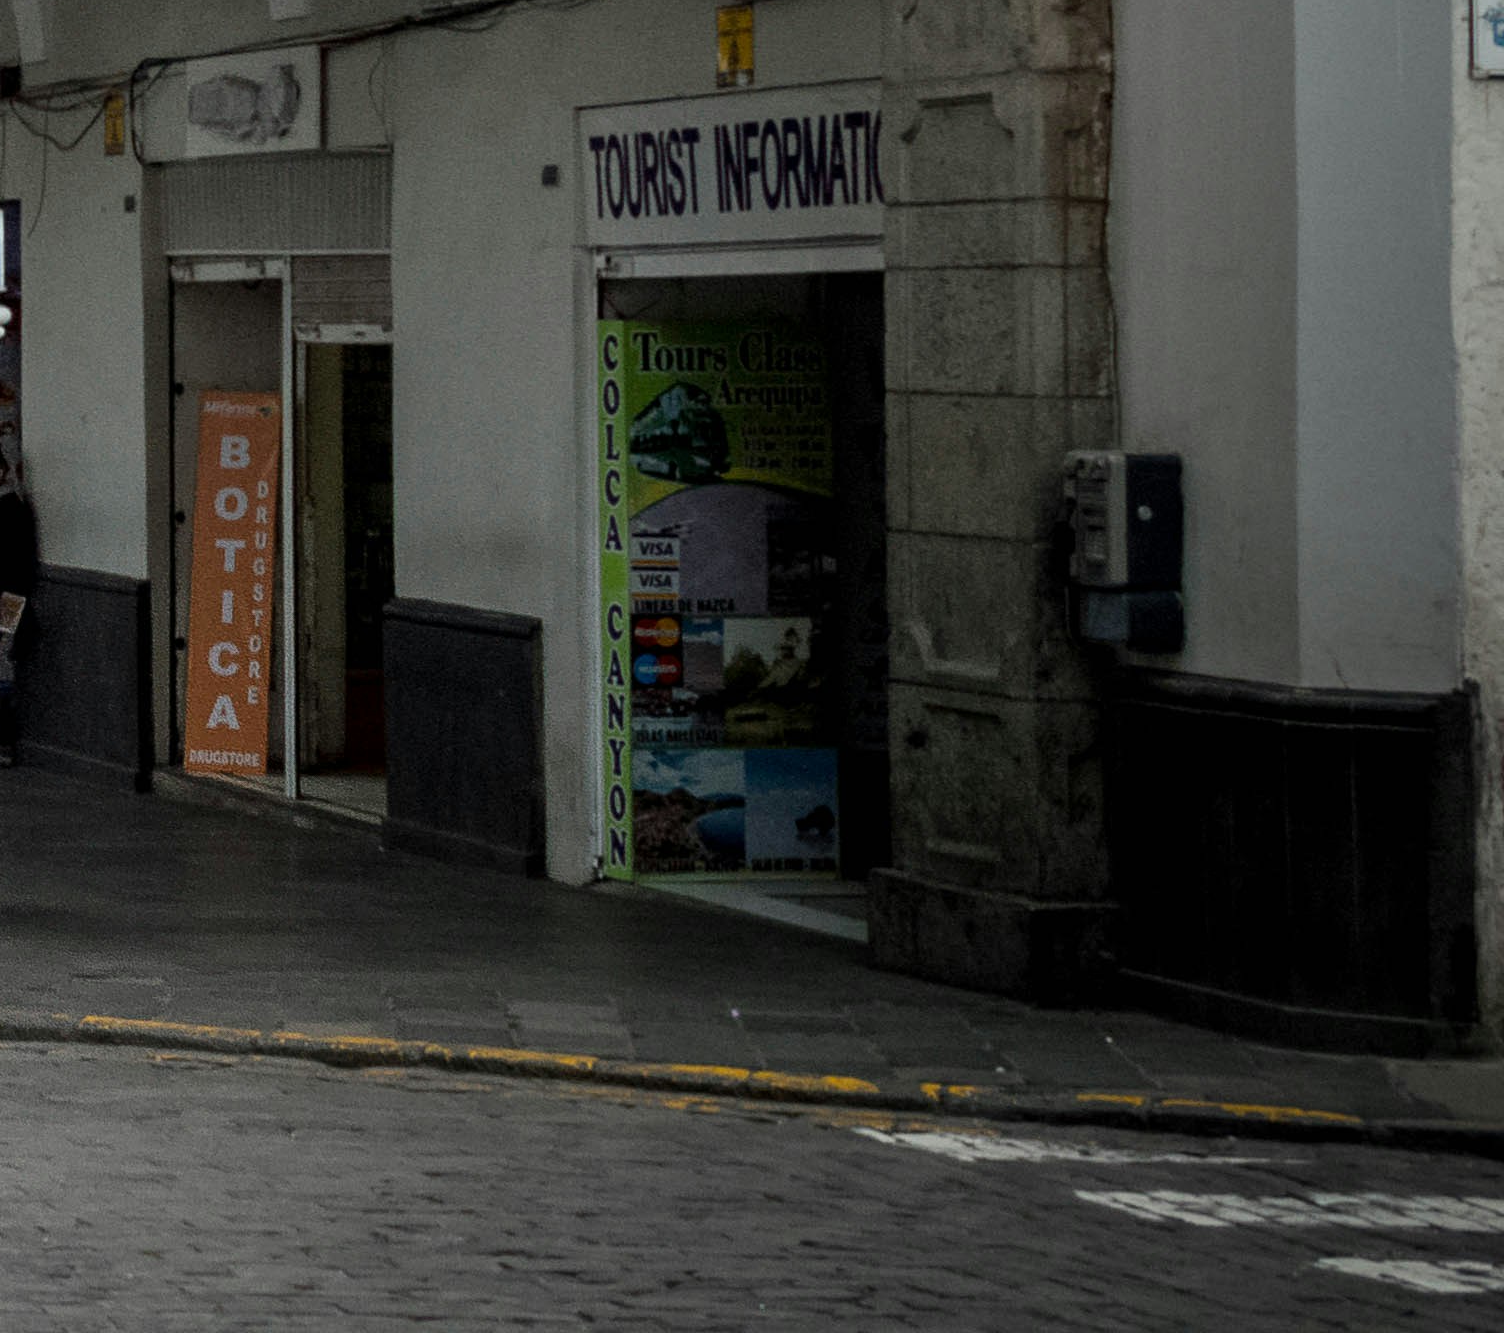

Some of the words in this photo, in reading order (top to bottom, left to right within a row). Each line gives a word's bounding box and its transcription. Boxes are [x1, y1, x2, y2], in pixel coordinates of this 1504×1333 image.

[590, 128, 699, 220] TOURIST
[634, 331, 728, 372] Tours
[739, 331, 824, 372] Class
[718, 379, 822, 413] Arequipa
[602, 334, 623, 552] COLCA
[639, 540, 674, 557] VISA
[639, 573, 672, 589] VISA
[205, 435, 251, 730] BOTICA
[247, 479, 270, 705] DRUGSTORE
[188, 747, 261, 768] DRUGSTORE
[607, 605, 626, 867] CANYON
